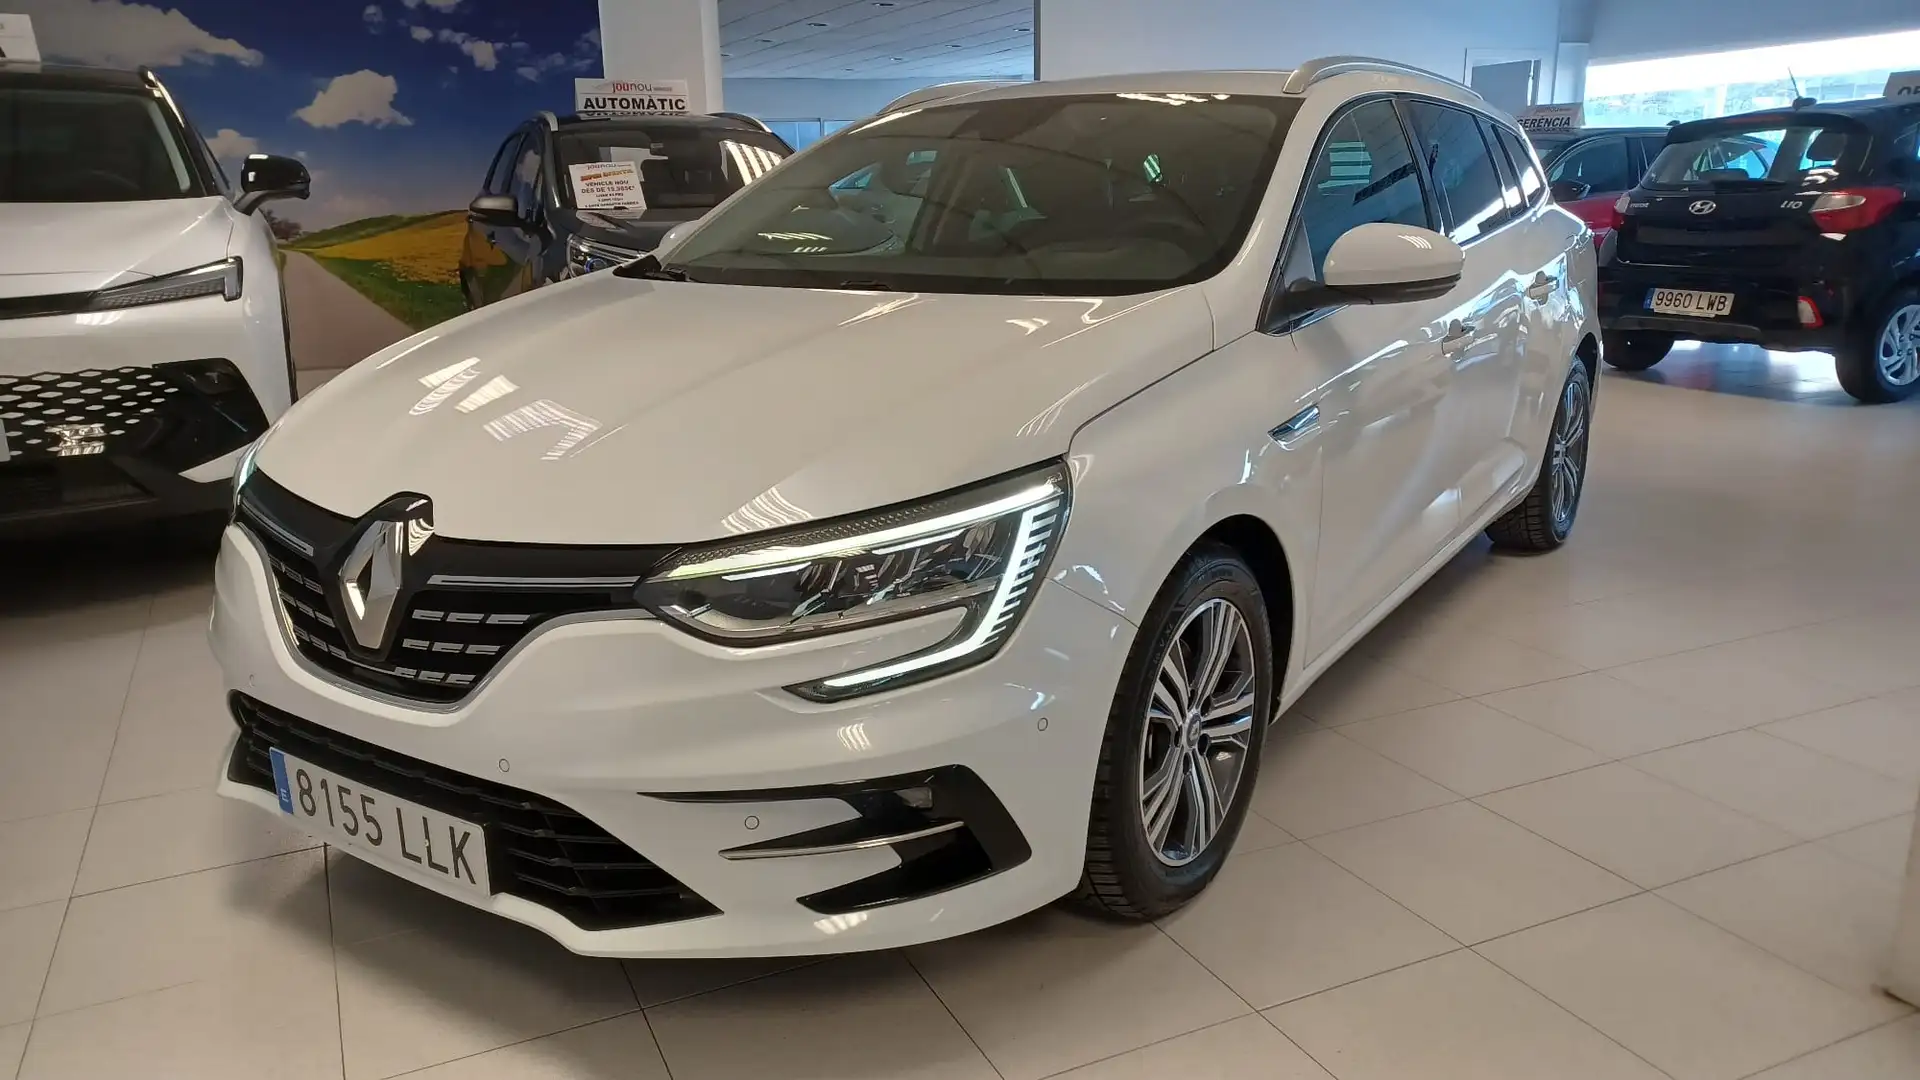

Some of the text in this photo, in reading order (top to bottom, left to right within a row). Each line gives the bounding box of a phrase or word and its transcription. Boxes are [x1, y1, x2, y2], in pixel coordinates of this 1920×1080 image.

[612, 82, 652, 93] jounou
[584, 95, 686, 110] AUTOMÀTIC
[1655, 291, 1727, 312] 9960 LWB
[280, 787, 289, 803] E
[296, 768, 477, 885] 8155 LLK
